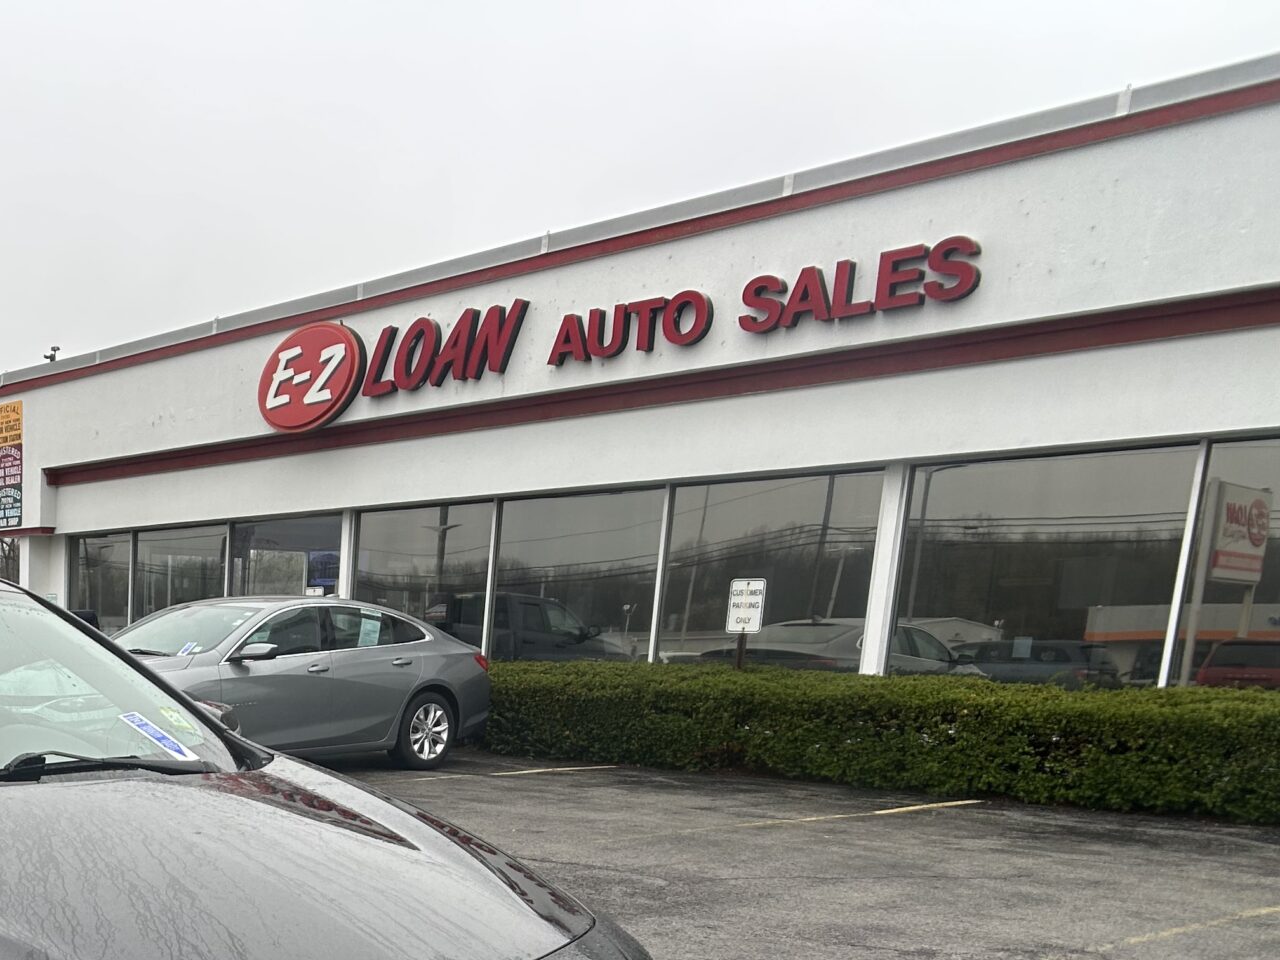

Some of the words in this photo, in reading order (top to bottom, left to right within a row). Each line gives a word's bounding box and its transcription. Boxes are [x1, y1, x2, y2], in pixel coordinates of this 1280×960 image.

[266, 343, 346, 409] E-Z
[362, 298, 530, 397] LOAN
[547, 290, 714, 366] AUTO
[738, 235, 982, 333] SALES
[5, 465, 22, 476] VEHICLE
[736, 616, 751, 624] ONLY
